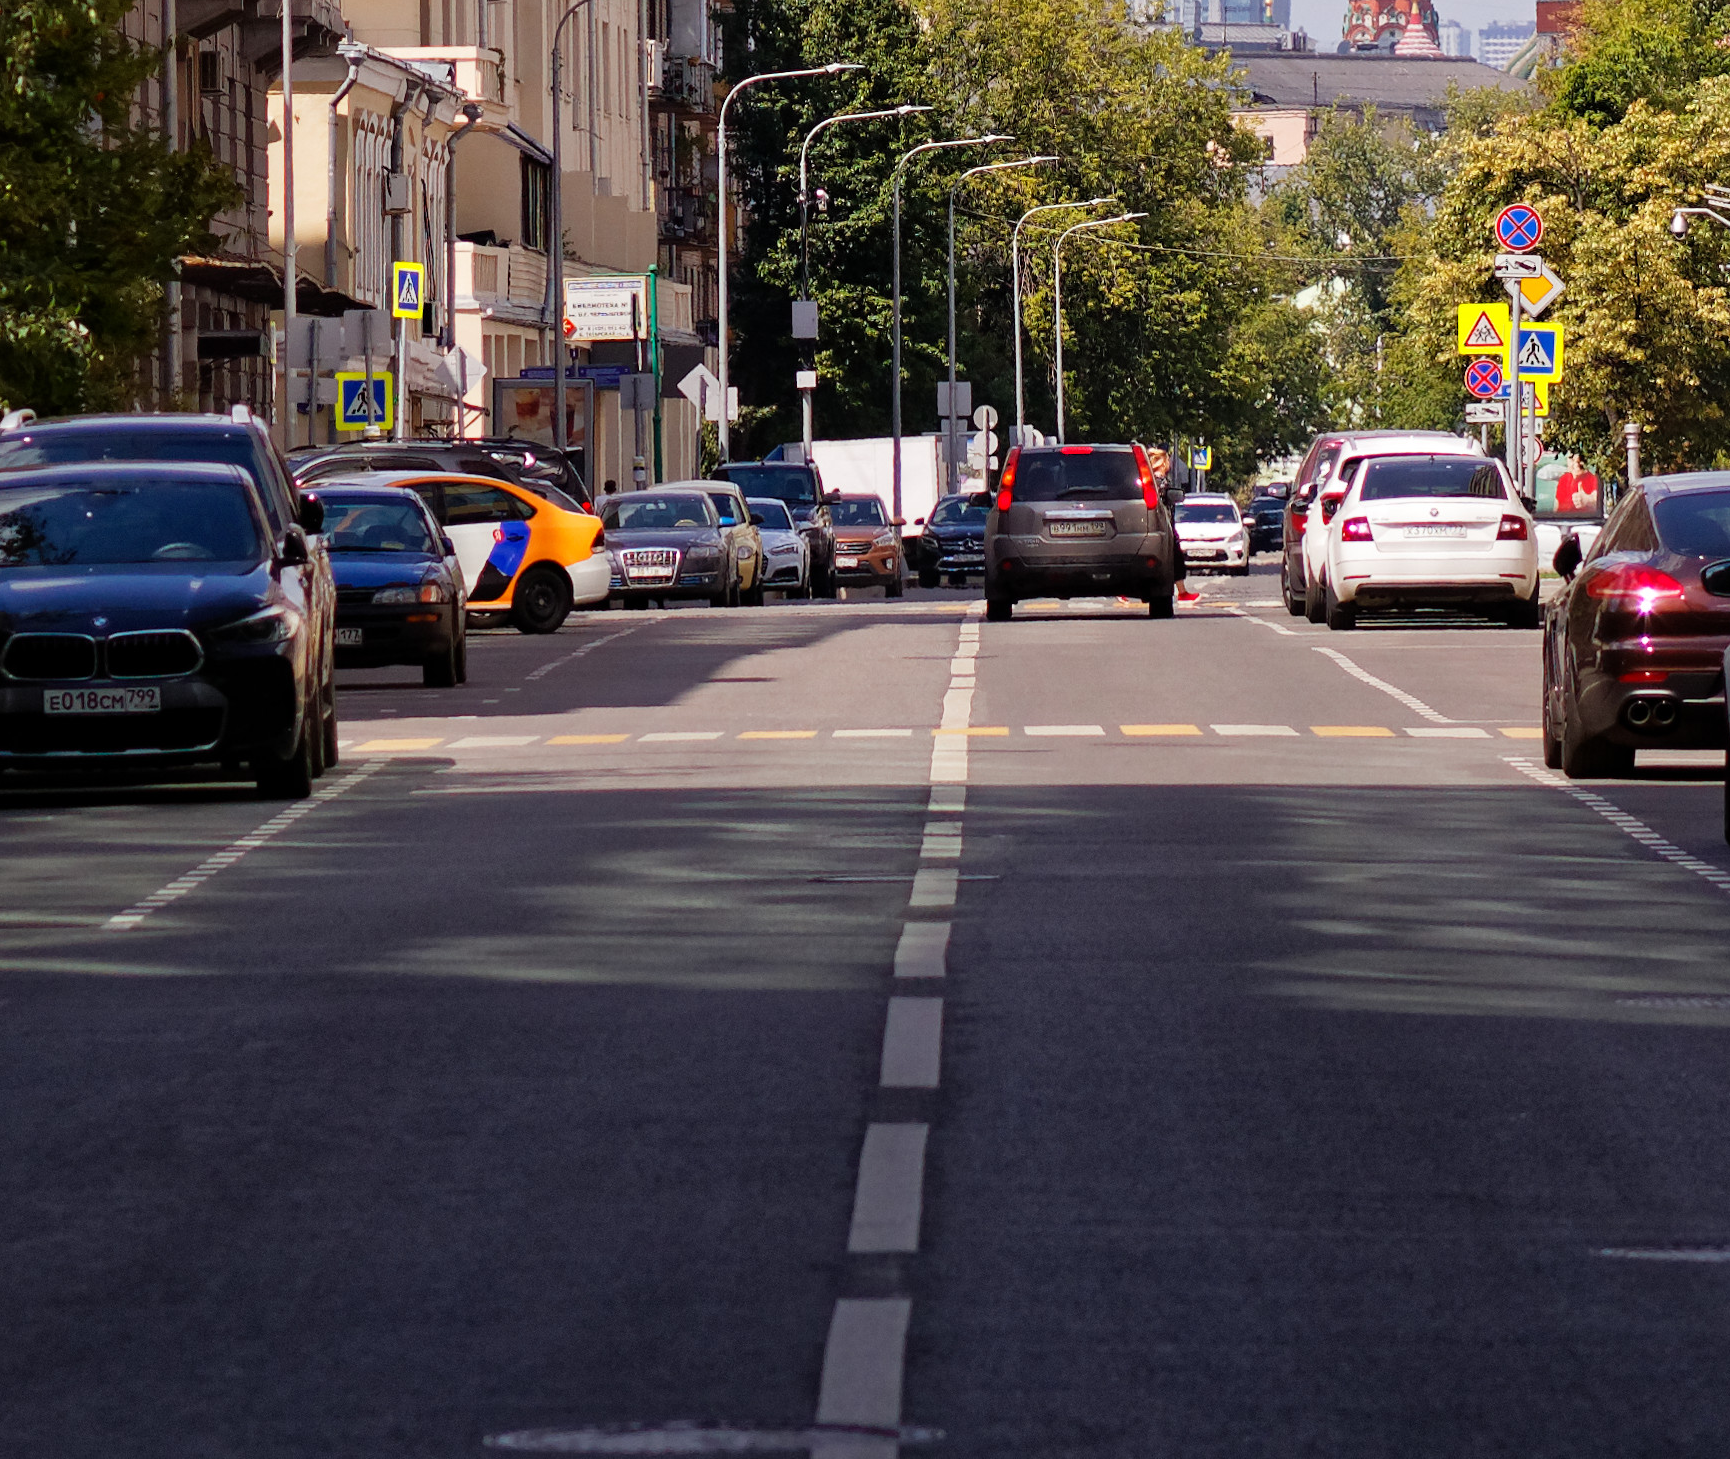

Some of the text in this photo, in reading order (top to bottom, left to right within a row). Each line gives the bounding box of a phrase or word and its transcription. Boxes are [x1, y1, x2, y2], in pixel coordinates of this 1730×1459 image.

[340, 629, 359, 639] 177
[50, 689, 156, 711] Е018СМ 799
